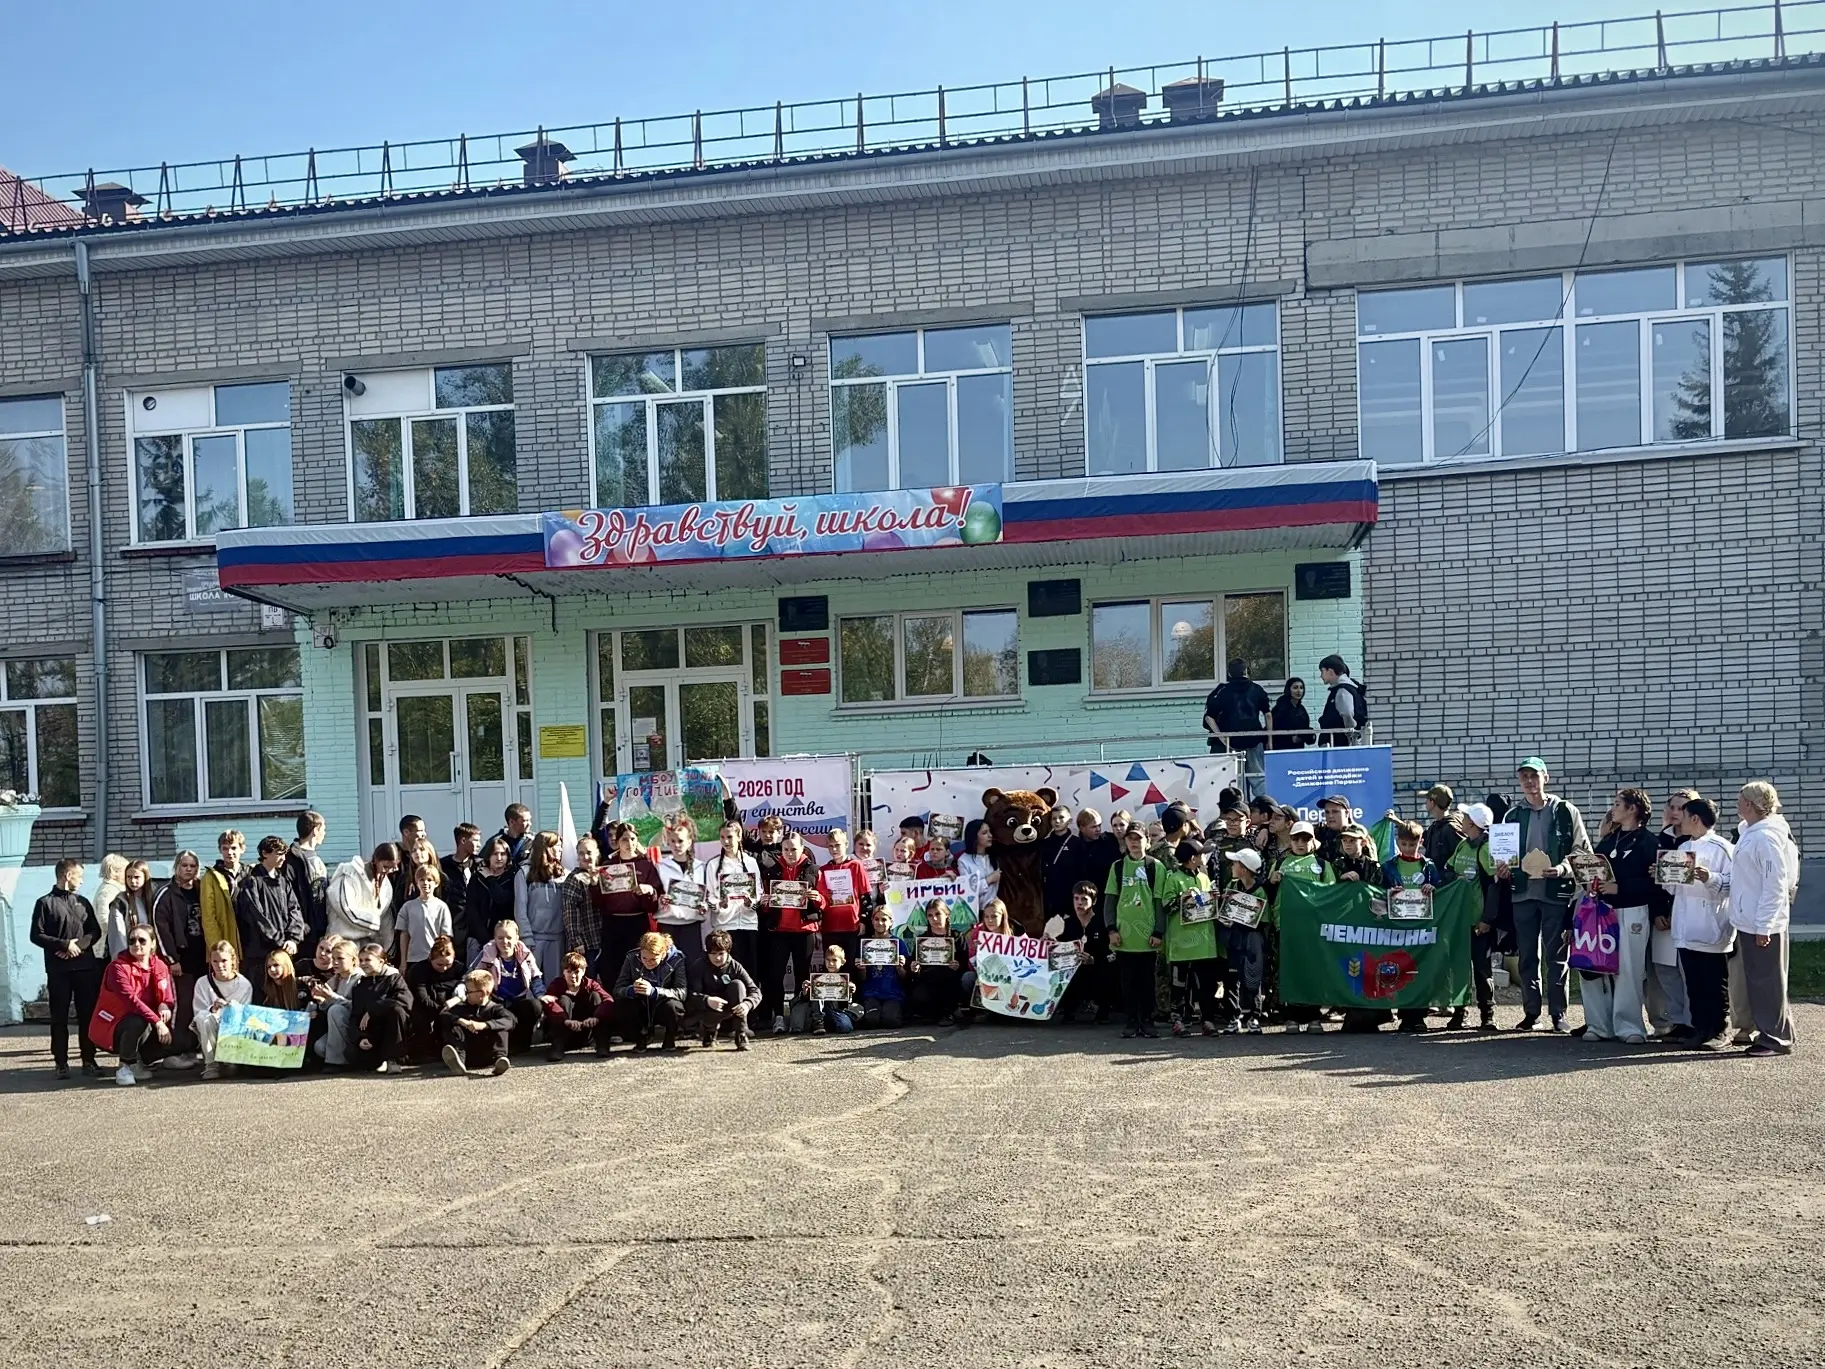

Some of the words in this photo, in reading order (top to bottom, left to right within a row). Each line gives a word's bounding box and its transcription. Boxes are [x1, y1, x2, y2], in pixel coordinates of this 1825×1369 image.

[577, 502, 807, 562] Здравствуй,
[815, 488, 975, 534] школа!
[189, 592, 220, 601] ШКОЛА
[1287, 768, 1331, 776] Российское
[1332, 766, 1370, 774] движение
[1296, 774, 1317, 782] детей
[738, 779, 772, 798] 2026
[777, 778, 805, 798] ГОД
[751, 801, 825, 818] единства
[1297, 807, 1363, 827] Пере
[1319, 923, 1437, 946] ЧЕМПИОНЫ
[1574, 924, 1616, 954] wb
